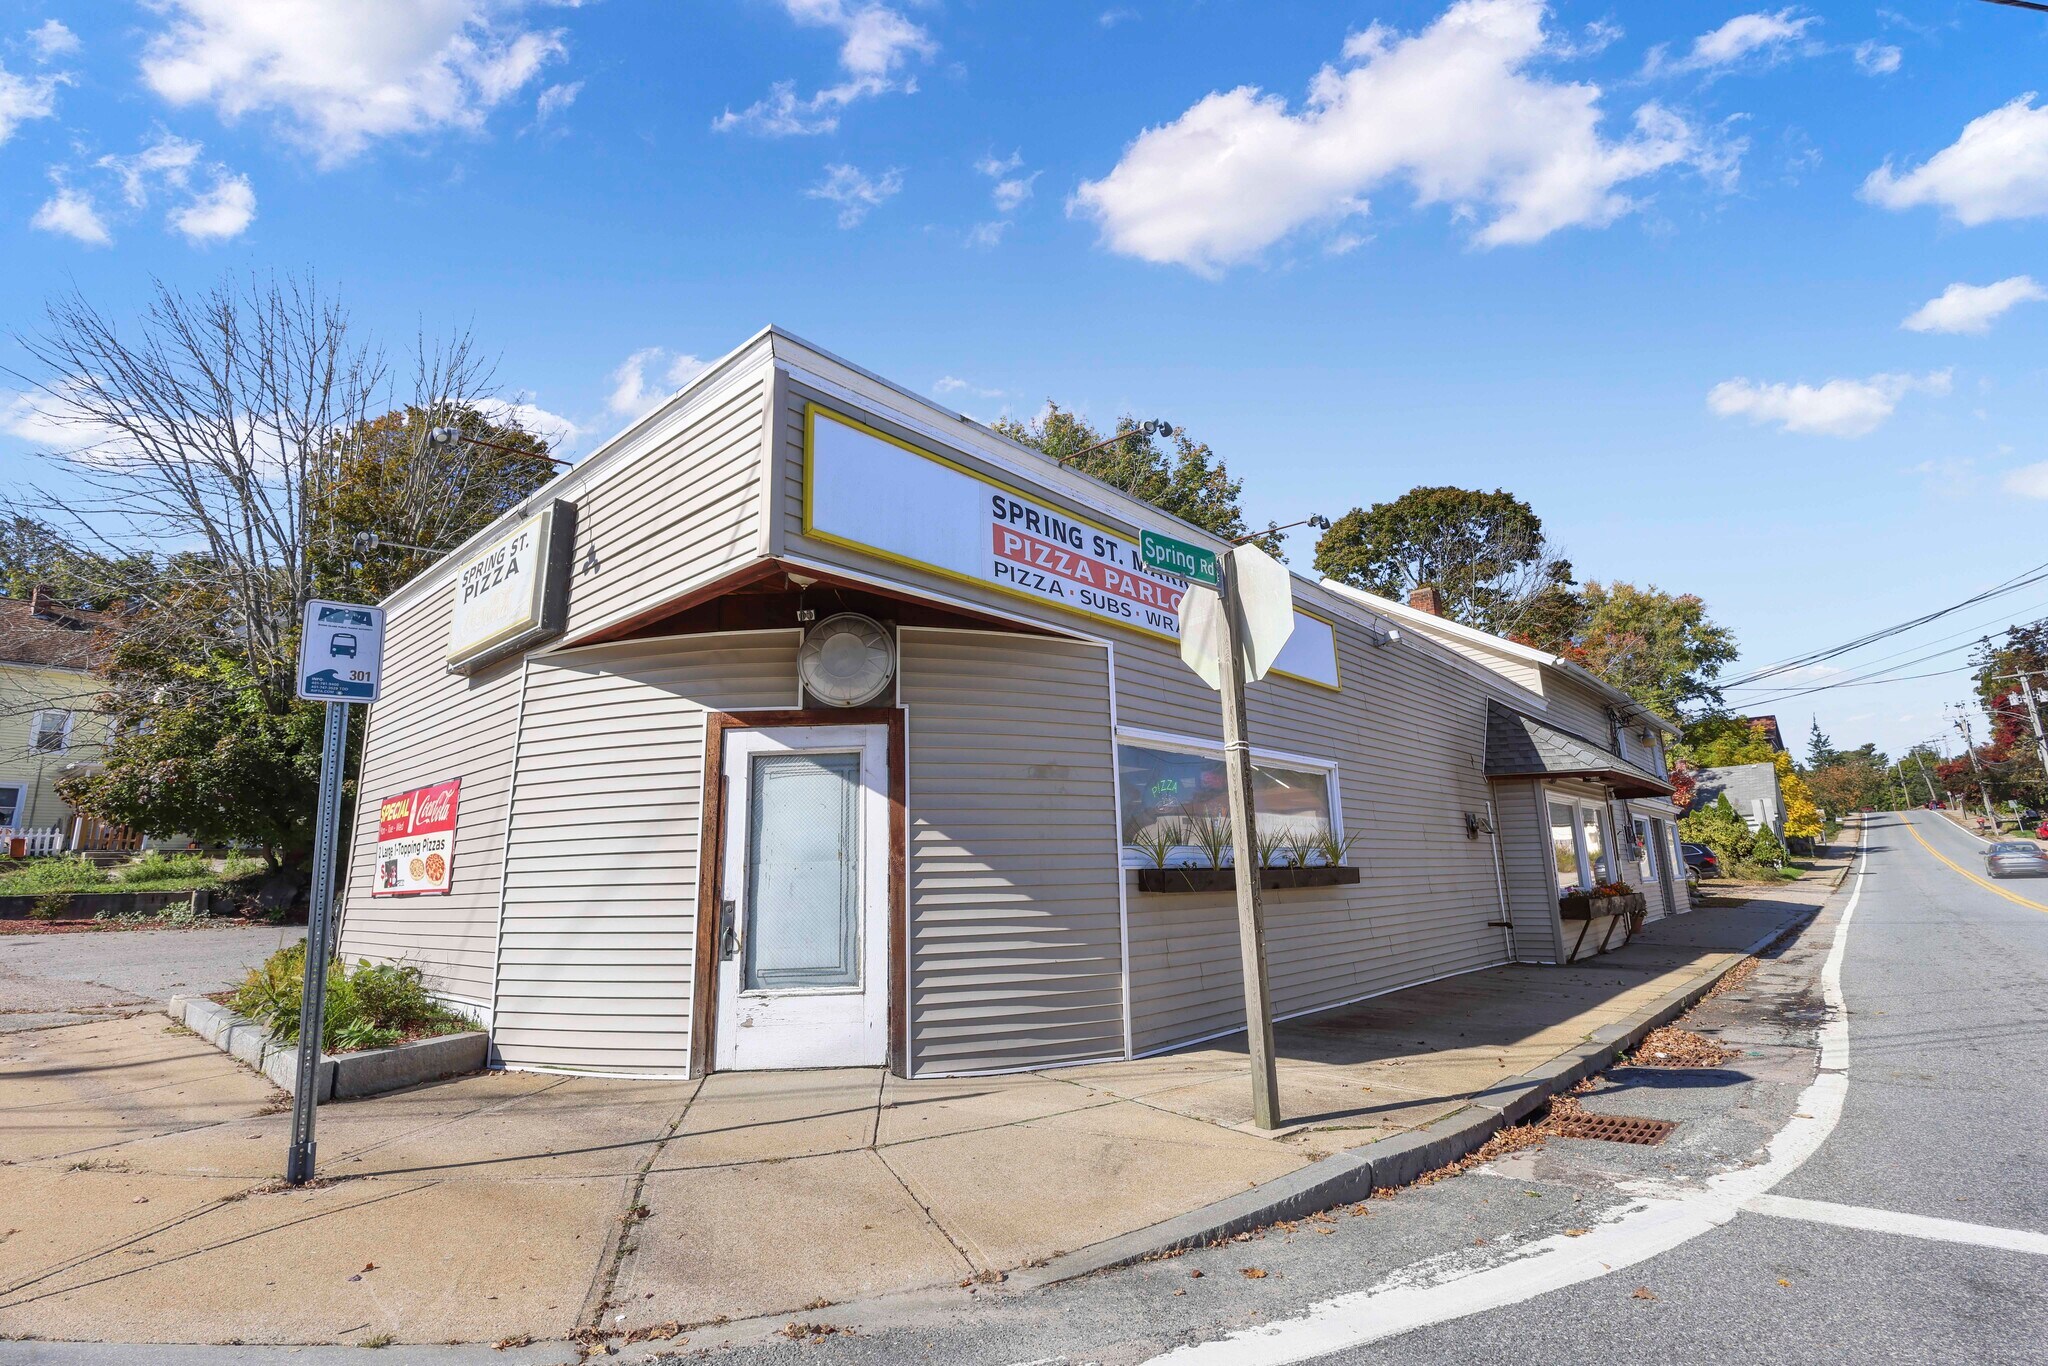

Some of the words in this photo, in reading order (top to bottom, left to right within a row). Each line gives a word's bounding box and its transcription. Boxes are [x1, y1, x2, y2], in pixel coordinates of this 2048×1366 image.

[992, 495, 1083, 550] SPRING
[1093, 535, 1124, 566] ST.
[461, 546, 507, 589] SPRING
[510, 532, 530, 558] ST.
[463, 557, 520, 605] PIZZA
[1003, 531, 1096, 583] PIZZA
[1104, 568, 1182, 612] PARLO
[1145, 538, 1196, 575] Spring
[1200, 558, 1215, 577] Rd
[993, 560, 1065, 598] PIZZA
[1080, 588, 1132, 618] SUBS
[349, 670, 371, 682] 301
[380, 798, 410, 823] SPECIAL
[382, 846, 393, 859] Large
[422, 838, 446, 853] Pizzas
